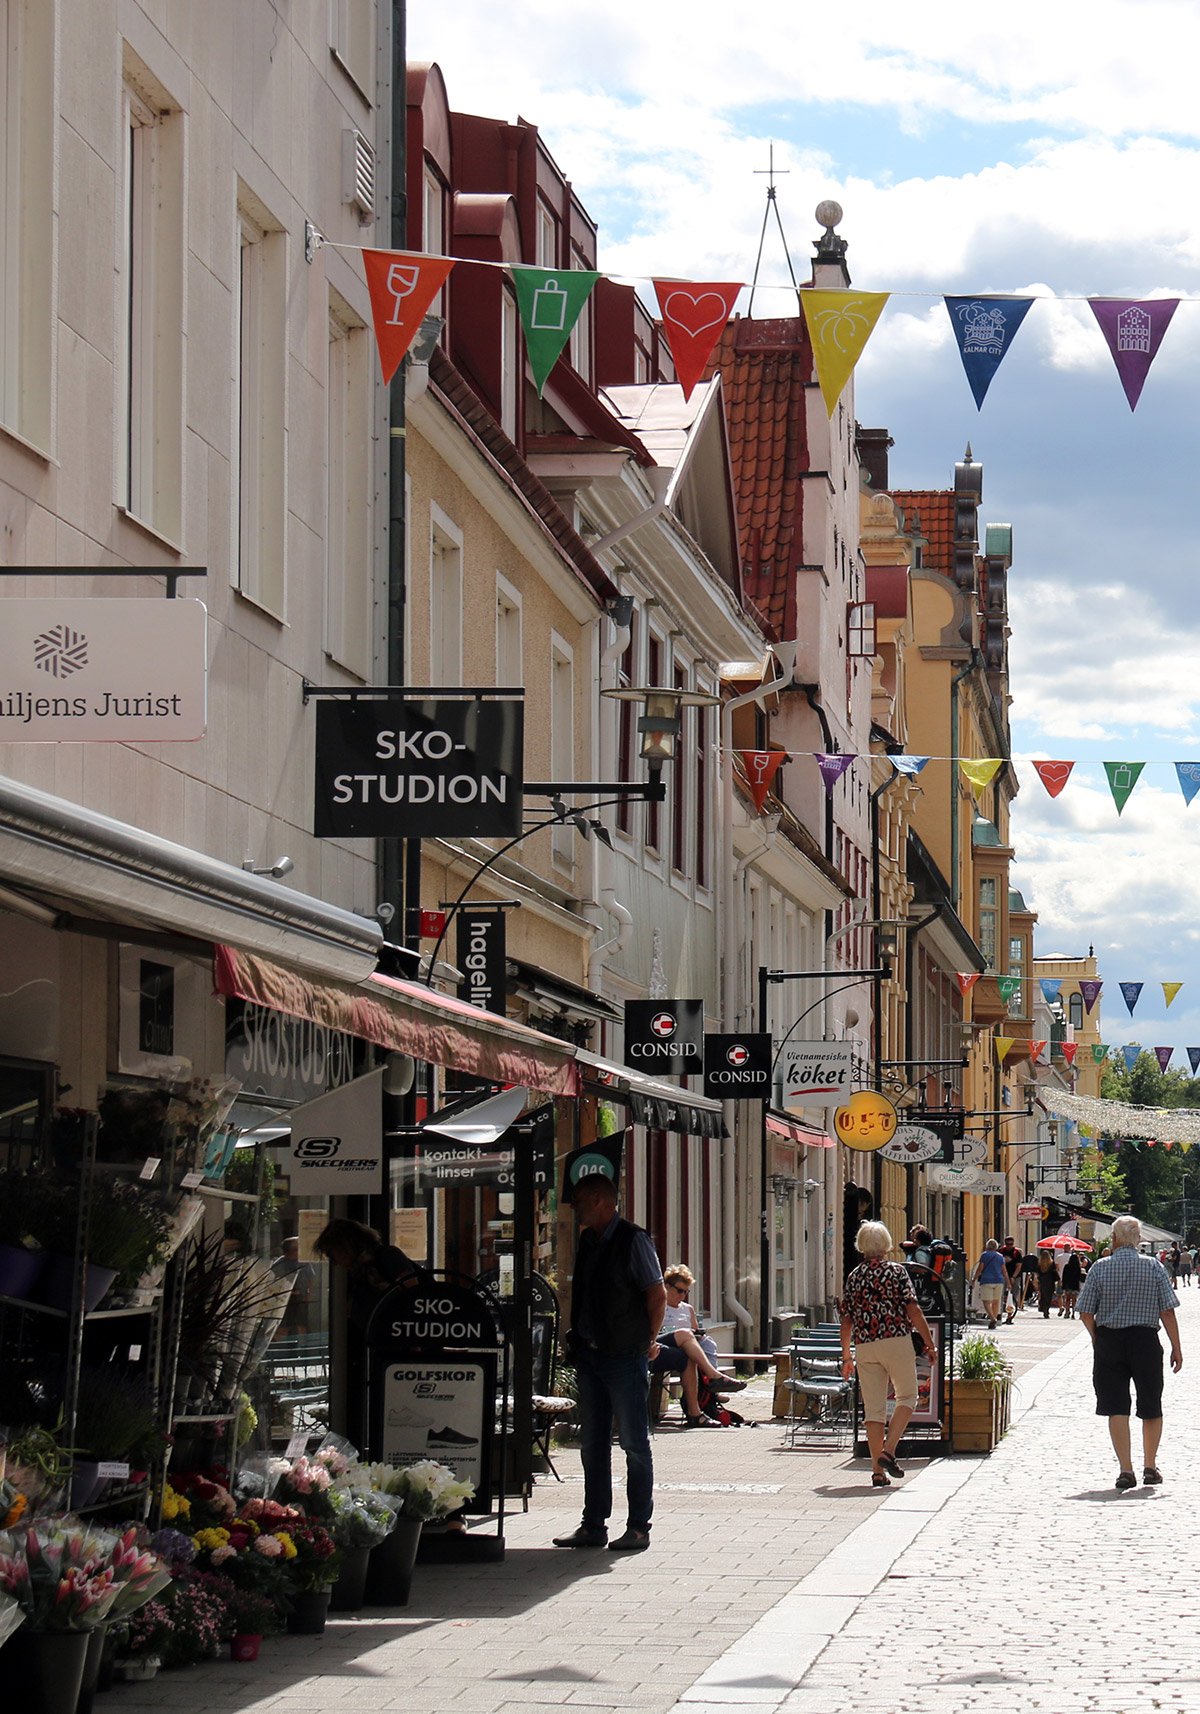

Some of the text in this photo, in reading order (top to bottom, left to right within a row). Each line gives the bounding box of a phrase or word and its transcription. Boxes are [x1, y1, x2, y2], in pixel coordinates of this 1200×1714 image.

[963, 346, 1002, 355] KALMAR CITY
[94, 692, 181, 717] Jurist
[375, 730, 467, 759] SKO-
[332, 774, 507, 804] STUDION
[630, 1042, 697, 1057] CONSID
[786, 1051, 847, 1061] Vietnamesiska
[709, 1070, 767, 1084] CONSID
[786, 1063, 847, 1084] köket
[424, 1147, 487, 1163] kontakt-
[300, 1158, 379, 1168] SKECHERS
[436, 1166, 476, 1178] linser
[413, 1298, 461, 1315] SKO-
[391, 1321, 481, 1338] STUDION
[393, 1370, 477, 1381] GOLFSKOR
